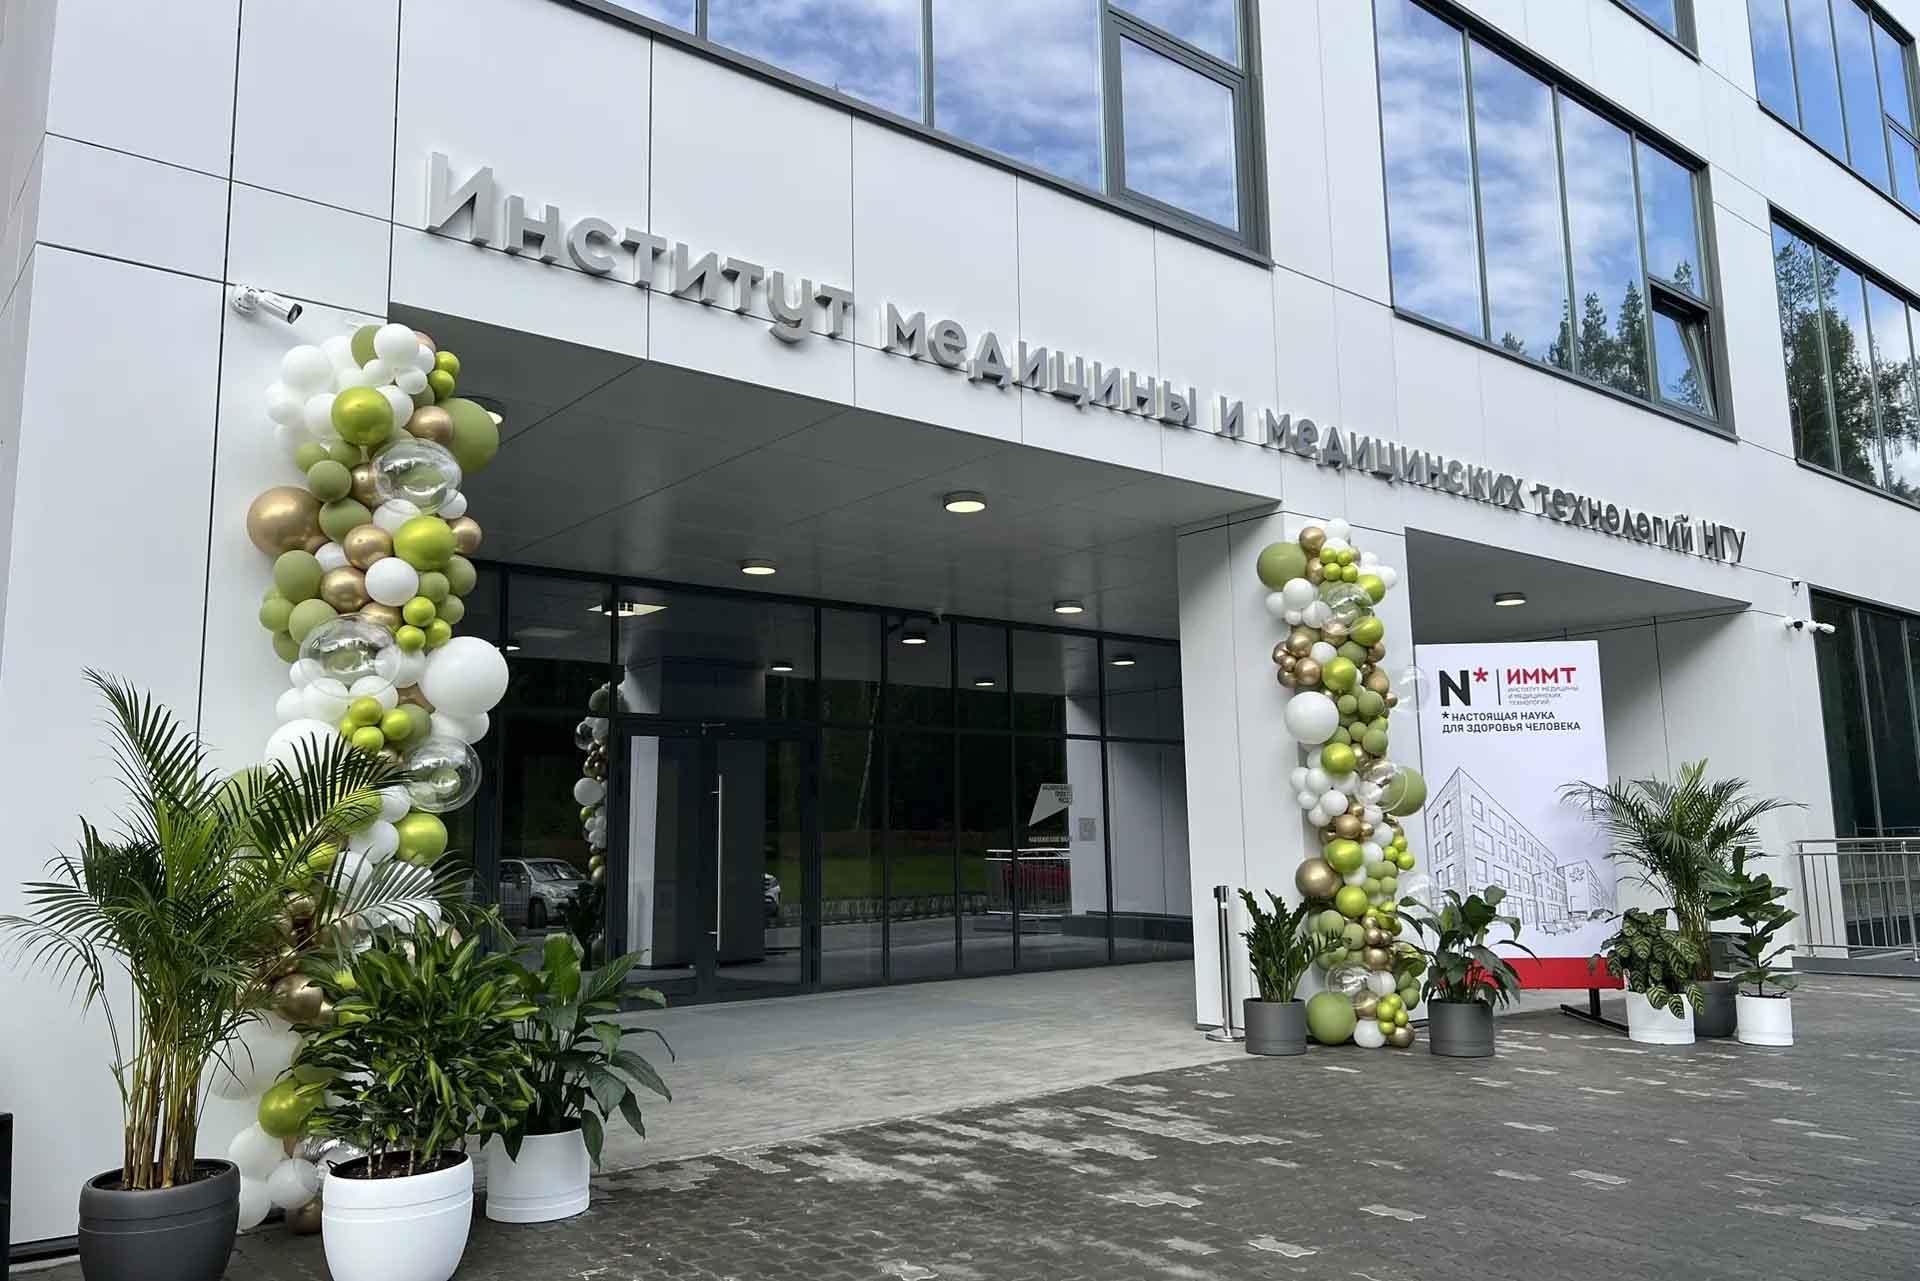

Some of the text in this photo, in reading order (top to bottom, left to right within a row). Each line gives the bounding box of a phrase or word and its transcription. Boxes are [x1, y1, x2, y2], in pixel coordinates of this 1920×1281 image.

[425, 151, 1747, 563] Институт медицины и медицинских технологий НГУ
[1507, 667, 1576, 684] ИММТ
[1520, 711, 1556, 721] НАУКА
[1442, 721, 1581, 733] ДЛЯ ЗДОРОВЬЯ ЧЕЛОВЕКА
